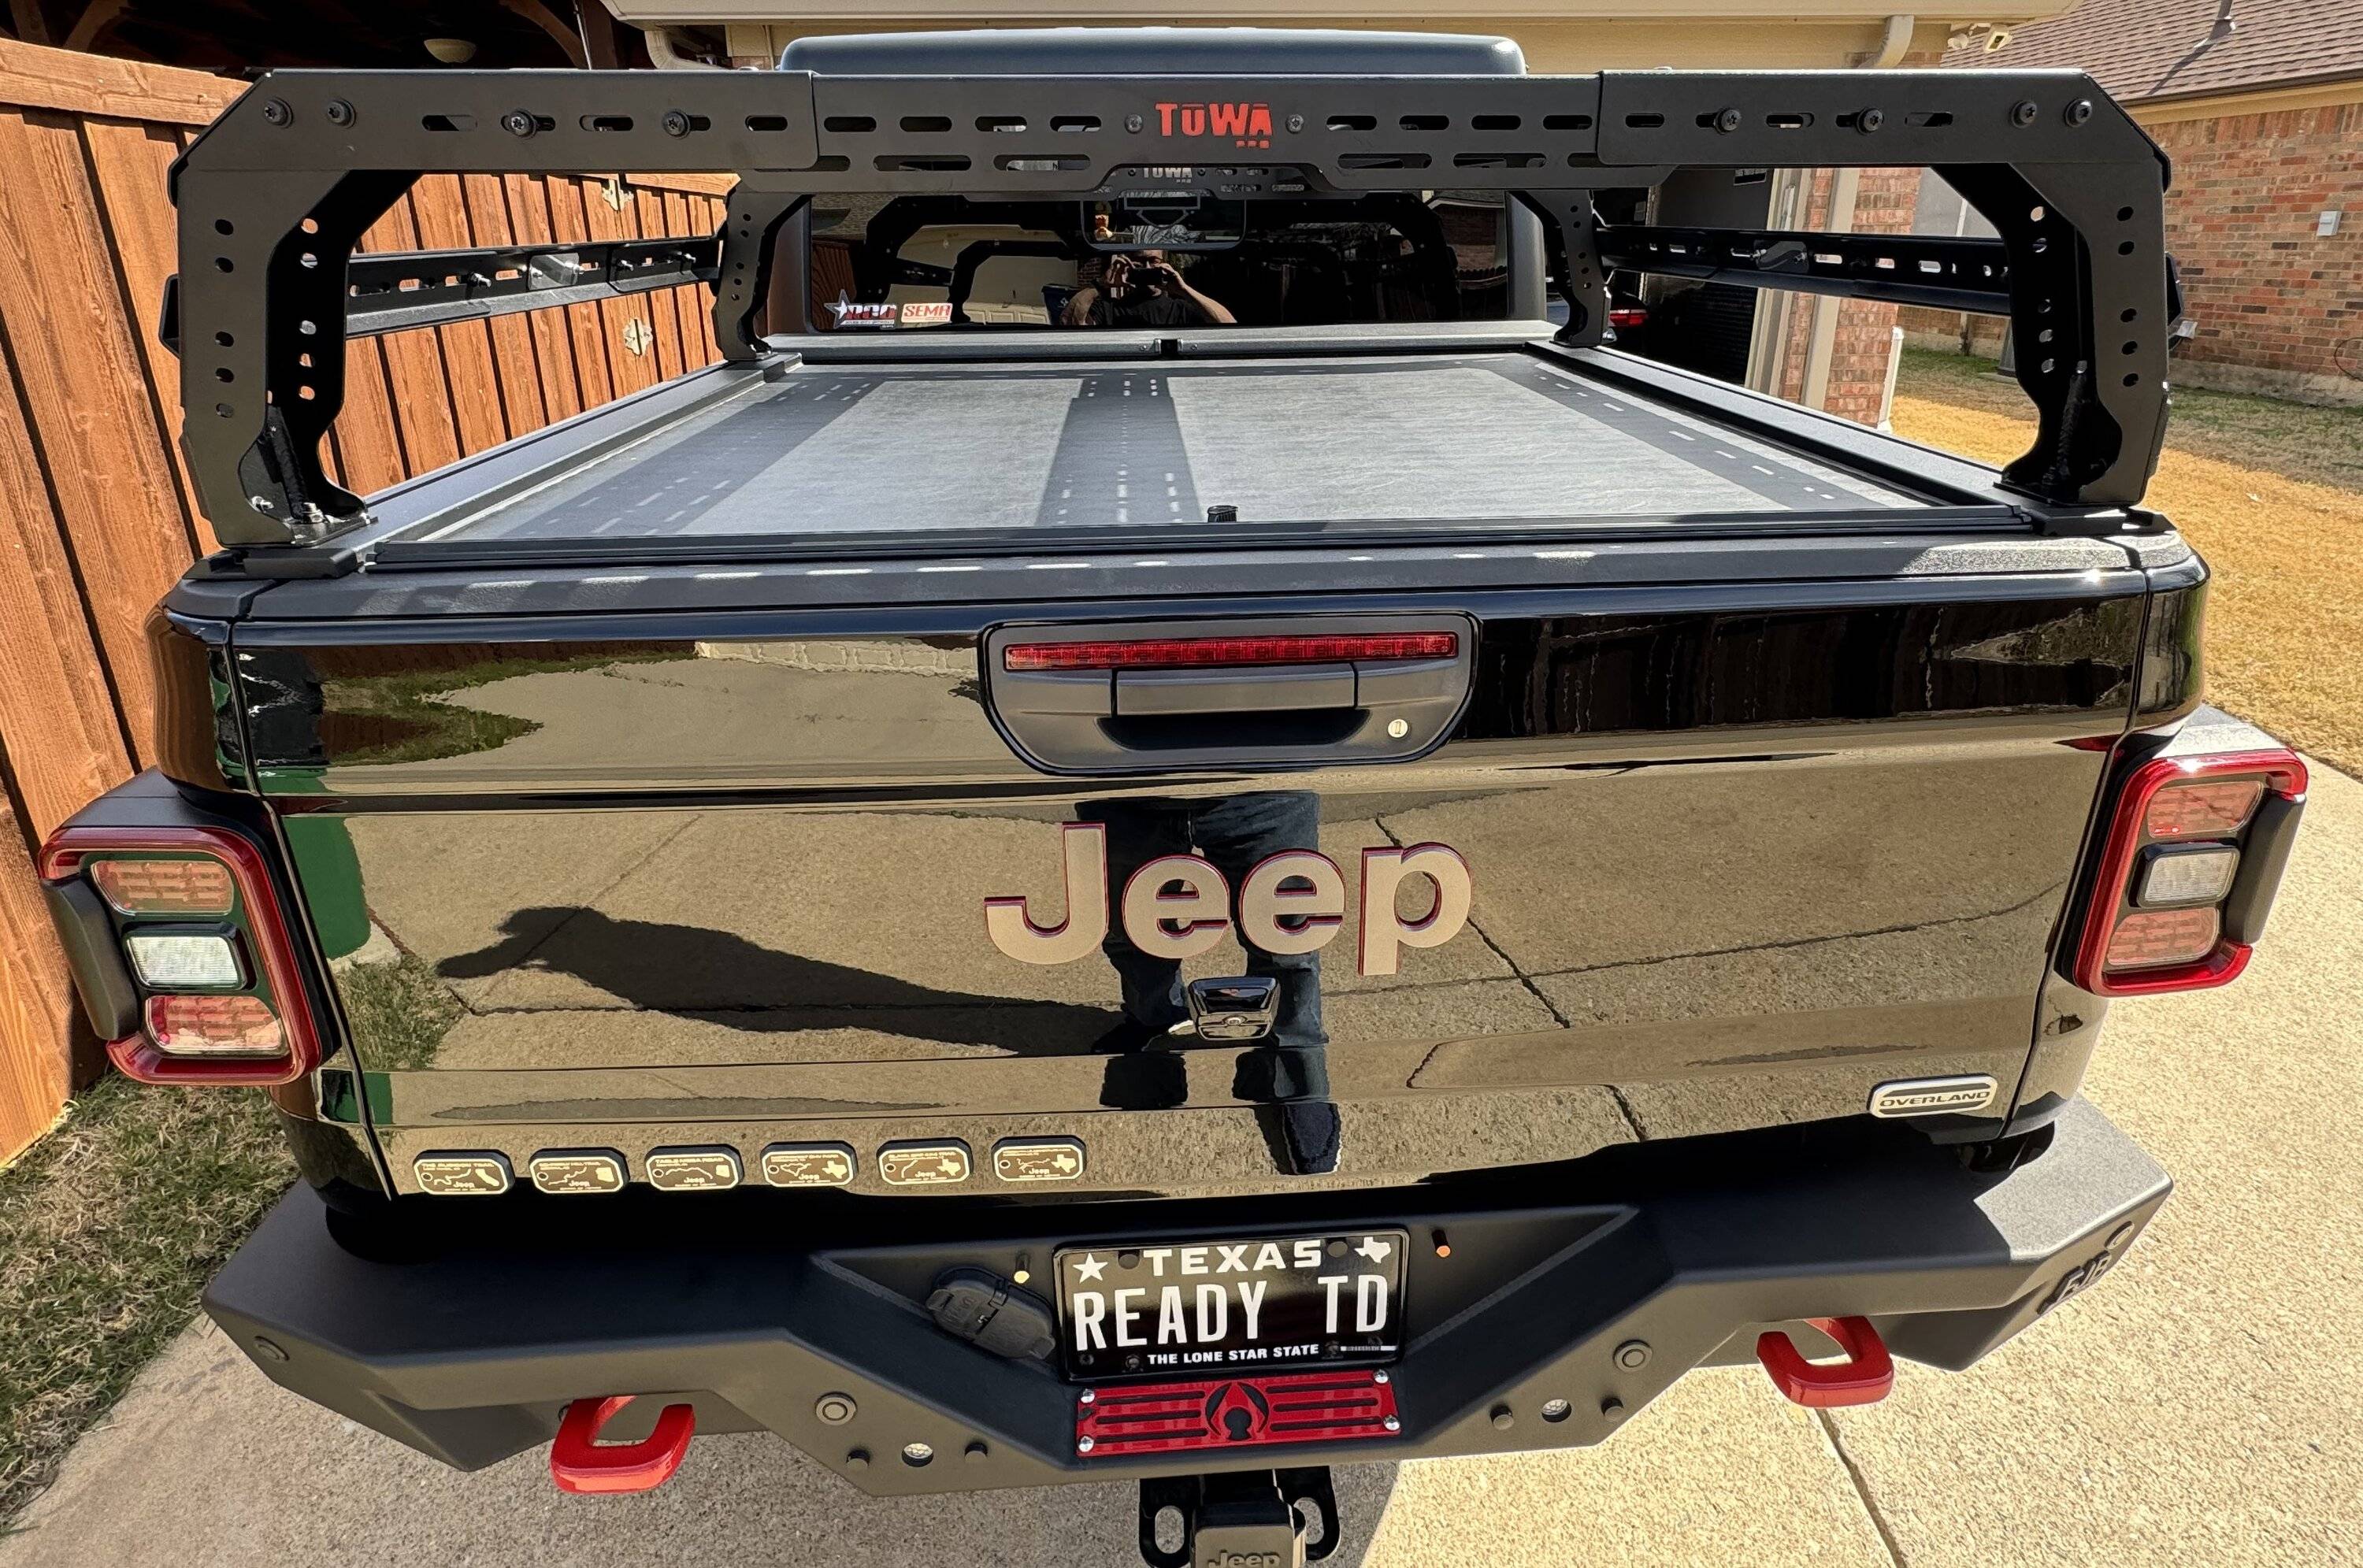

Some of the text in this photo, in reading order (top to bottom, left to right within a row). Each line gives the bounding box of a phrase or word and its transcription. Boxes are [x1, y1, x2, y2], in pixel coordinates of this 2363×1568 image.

[904, 305, 951, 317] SEMA
[984, 821, 1473, 977] Jeep
[1879, 1091, 1990, 1107] OVERLAND
[1143, 1239, 1322, 1277] TEXAS
[1073, 1274, 1389, 1352] READY TD
[1147, 1344, 1319, 1366] THE LONE STAR STATE
[1207, 1549, 1282, 1568] Jeep
